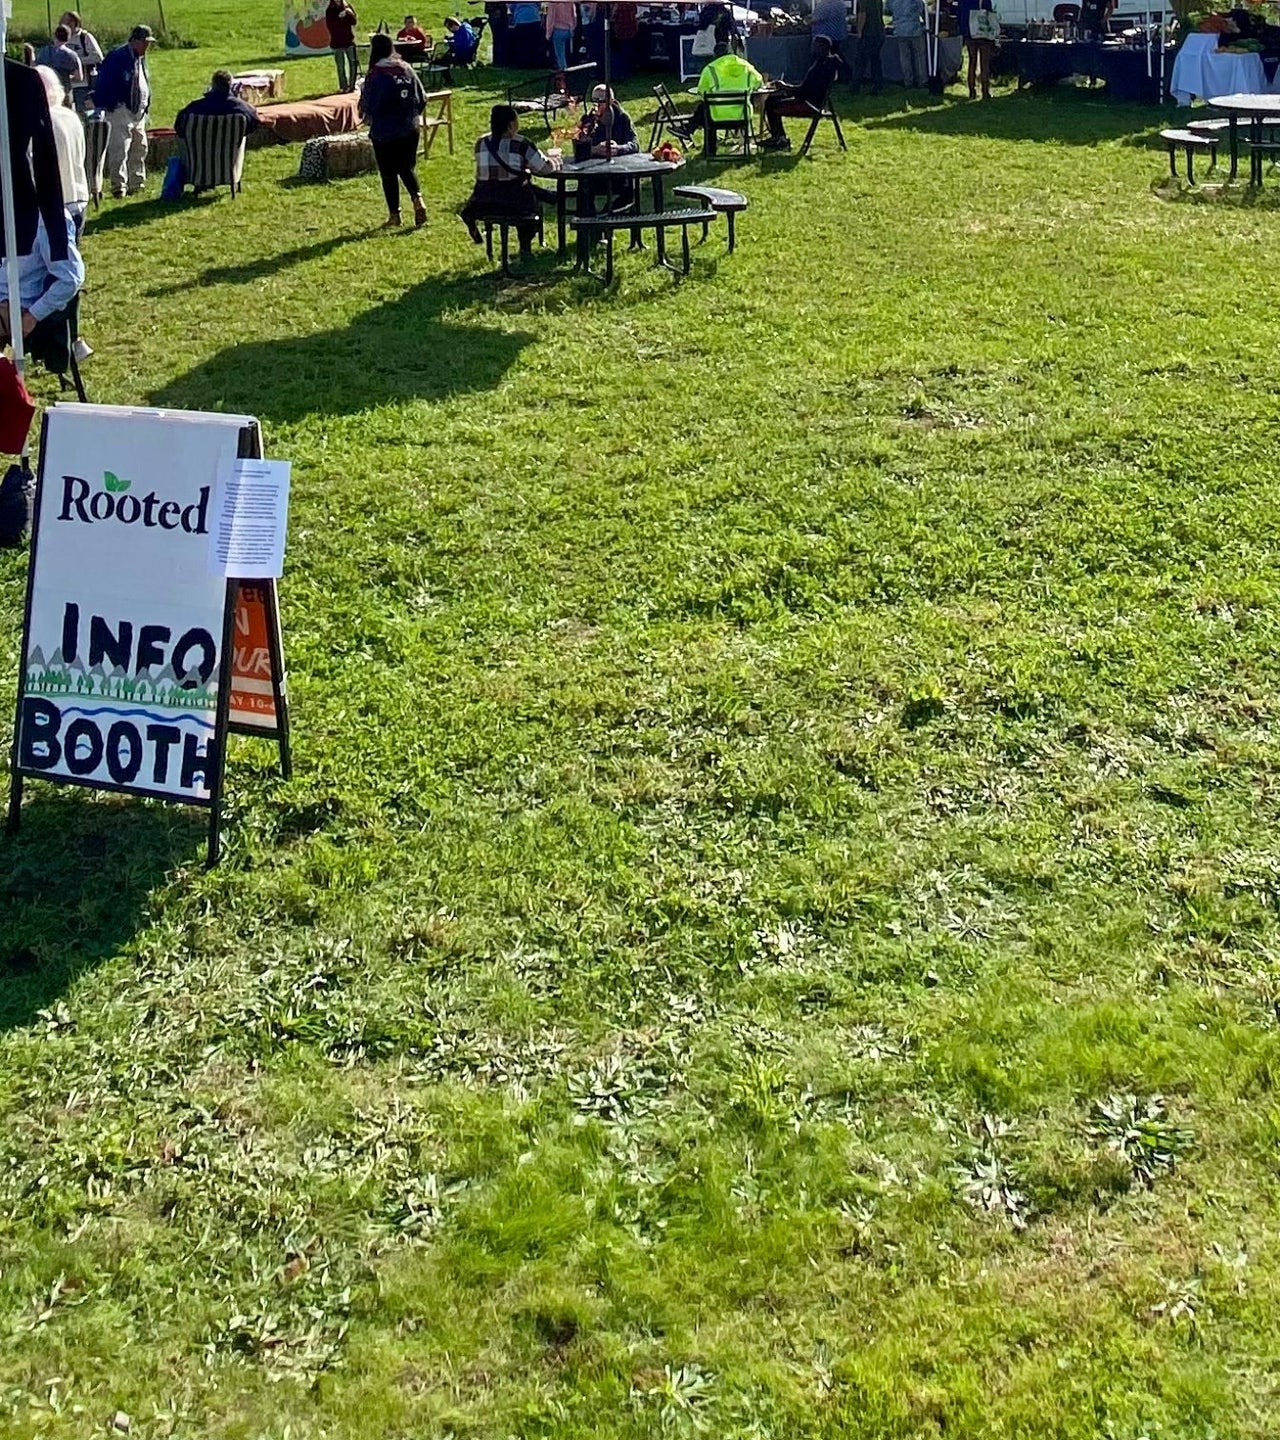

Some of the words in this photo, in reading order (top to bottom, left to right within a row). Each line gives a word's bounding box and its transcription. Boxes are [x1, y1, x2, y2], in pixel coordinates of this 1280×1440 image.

[57, 474, 210, 535] Rooted
[62, 602, 217, 690] INFO
[21, 696, 217, 790] BOOTH
